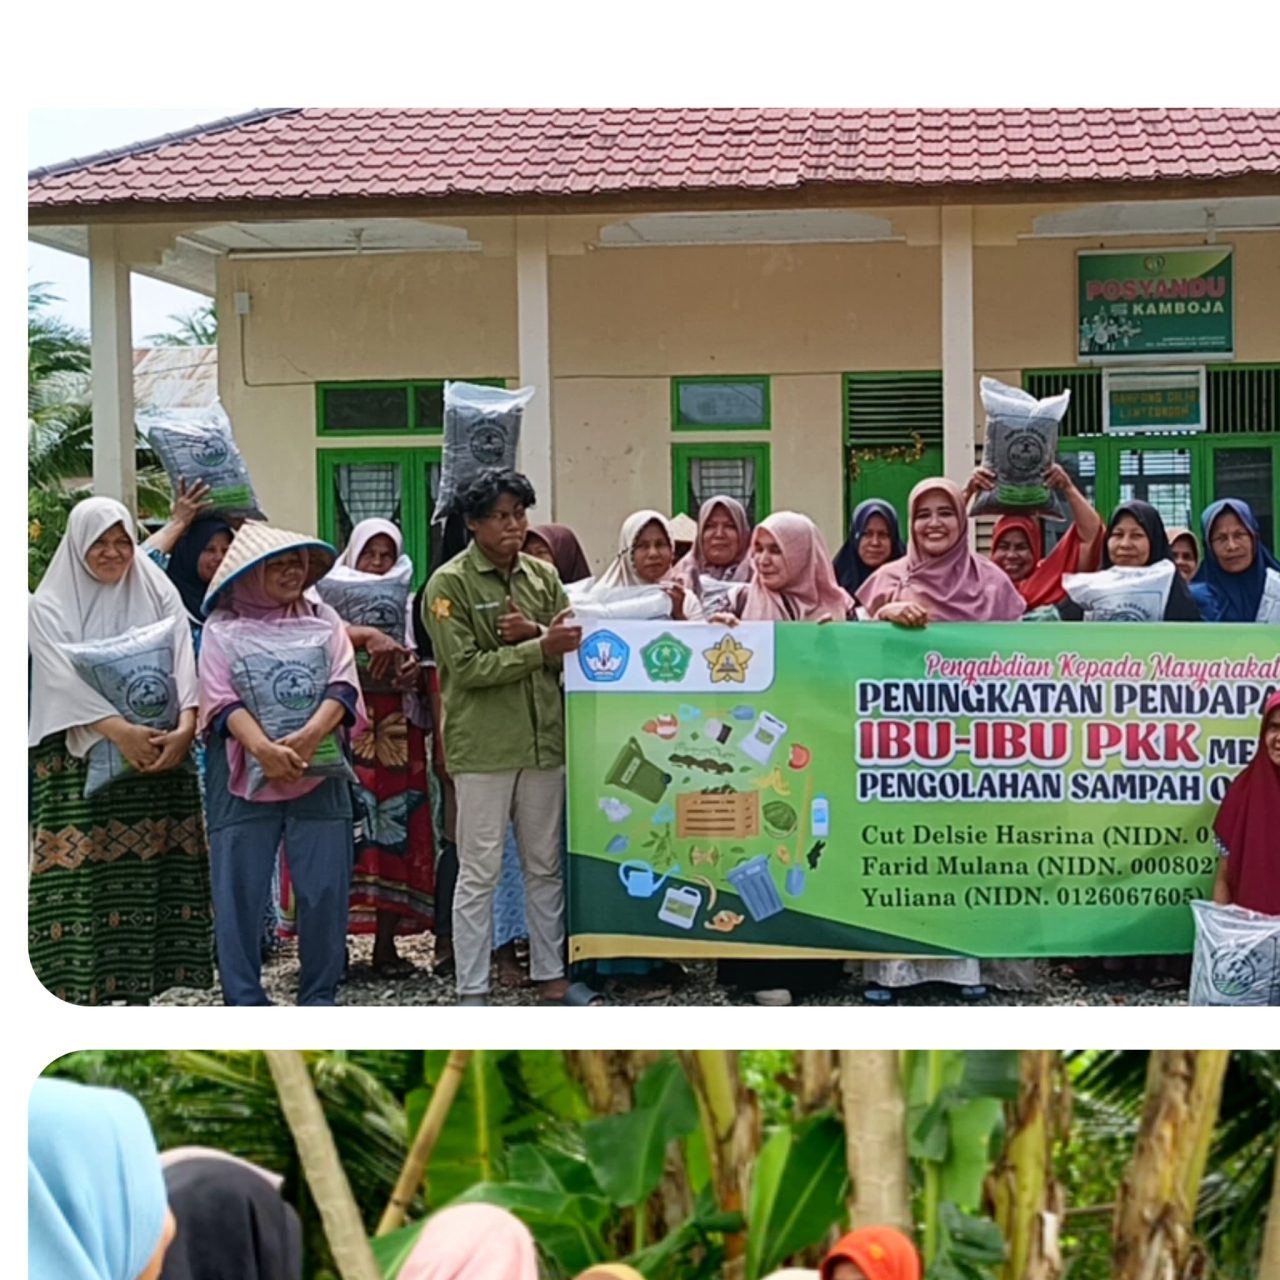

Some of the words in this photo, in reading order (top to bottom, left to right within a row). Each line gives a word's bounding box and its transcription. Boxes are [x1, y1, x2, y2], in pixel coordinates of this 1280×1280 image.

[1086, 276, 1226, 300] POSYANDU
[1132, 301, 1225, 315] KAMBOJA
[926, 653, 1052, 686] Pengabdian
[1058, 653, 1143, 683] Kepada
[859, 682, 1103, 714] PENINGKATAN
[859, 720, 1068, 761] IBU-IBU
[1087, 721, 1200, 762] PKK
[859, 771, 1061, 800] PENGOLAHAN
[1071, 772, 1200, 801] SAMPAH
[861, 824, 906, 845] Cut
[912, 824, 988, 845] Delsie
[996, 824, 1095, 845] Hasrina
[1103, 826, 1188, 848] (NIDN.
[862, 856, 929, 877] Farid
[937, 855, 1029, 877] Mulana
[1037, 856, 1123, 878] (NIDN.
[1131, 856, 1219, 875] 000802
[862, 887, 956, 908] Yuliana
[964, 886, 1049, 909] (NIDN.
